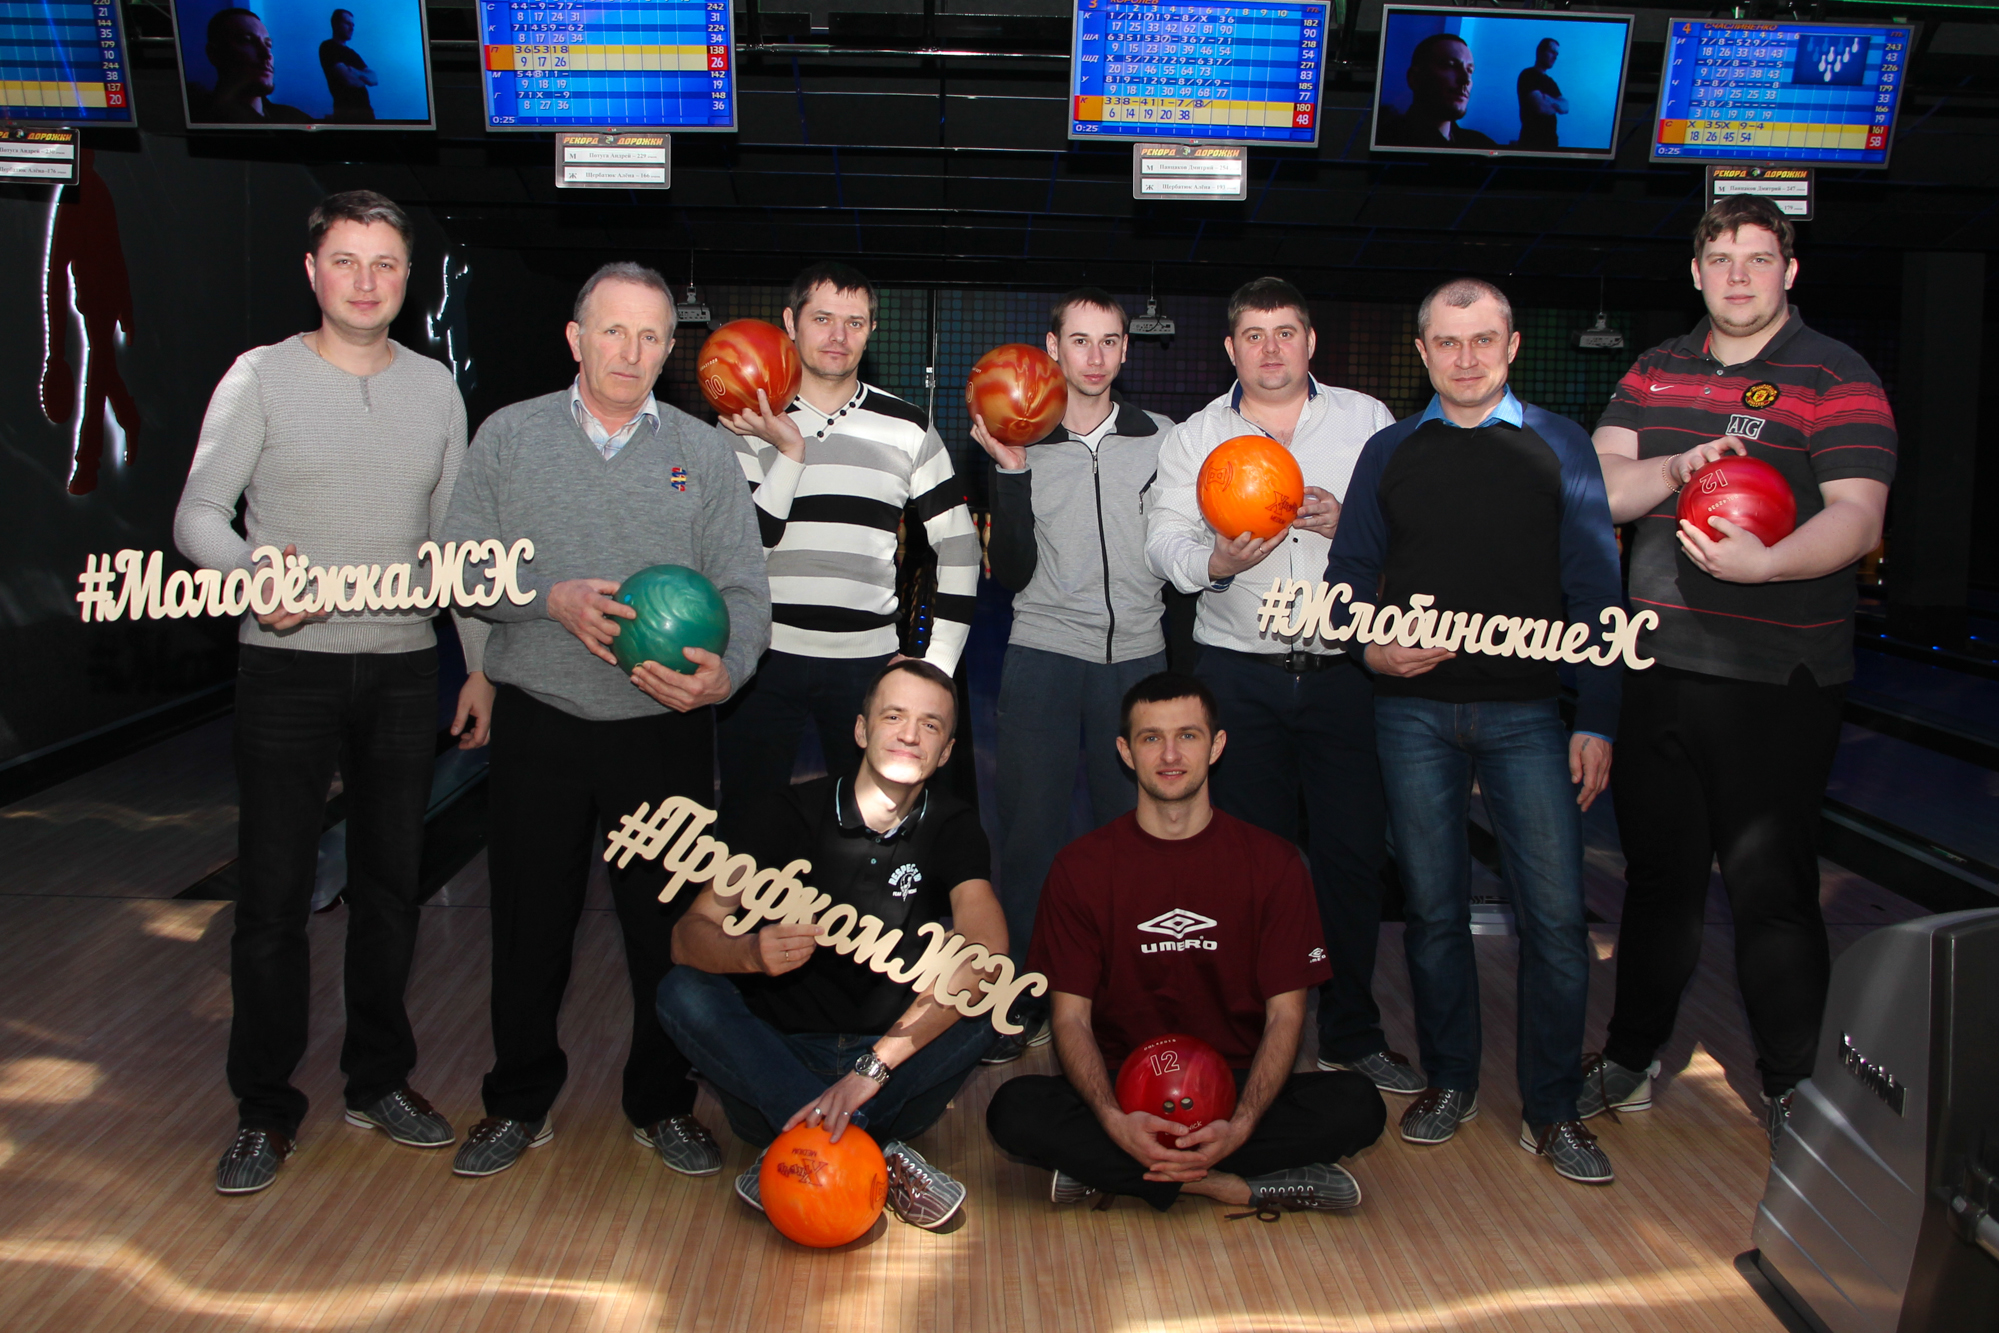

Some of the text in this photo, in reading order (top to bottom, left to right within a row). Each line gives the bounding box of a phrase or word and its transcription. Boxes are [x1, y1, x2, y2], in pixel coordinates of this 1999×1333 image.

[99, 8, 108, 16] 21
[517, 12, 580, 21] 8 17 24 31
[710, 12, 720, 22] 31
[1303, 19, 1319, 27] 182
[707, 24, 725, 32] 224
[1112, 22, 1233, 35] 17 25 33 42 62 81 90
[1682, 23, 1692, 34] 4
[101, 29, 112, 38] 35
[518, 33, 583, 43] 8 17 26 34
[1303, 29, 1317, 38] 90
[710, 34, 723, 43] 34
[709, 46, 724, 54] 138
[1111, 43, 1231, 56] 9 15 23 30 39 46 54
[104, 51, 115, 59] 10
[1302, 50, 1315, 59] 54
[1885, 53, 1898, 61] 43
[521, 56, 567, 67] 9 17 26
[711, 57, 724, 68] 26
[1108, 64, 1211, 76] 20 37 46 55 64 73
[106, 72, 118, 80] 38
[1300, 71, 1313, 80] 83
[1881, 73, 1894, 82] 43
[521, 79, 567, 89] 9 18 19
[713, 80, 723, 89] 19
[1299, 82, 1313, 90] 185
[1110, 85, 1228, 98] 9 18 21 30 49 68 77
[1299, 92, 1311, 100] 77
[110, 95, 122, 104] 20
[1877, 94, 1890, 103] 33
[524, 101, 569, 110] 8 27 36
[712, 101, 725, 110] 36
[1296, 104, 1311, 112] 180
[1109, 108, 1190, 121] 6 14 19 20 38
[1875, 115, 1885, 123] 19
[1296, 114, 1309, 125] 48
[1872, 126, 1884, 134] 161
[27, 132, 72, 141] ДОРОЖКИ
[563, 137, 599, 145] РЕКОРД
[1690, 131, 1752, 143] 18 26 45 54
[1869, 136, 1881, 147] 58
[1141, 148, 1240, 157] РЕКОРД ДОРОЖКИ
[1764, 170, 1809, 178] ДОРОЖКИ
[1728, 417, 1760, 437] AIG
[1699, 469, 1729, 494] 12
[1150, 1050, 1180, 1076] 12
